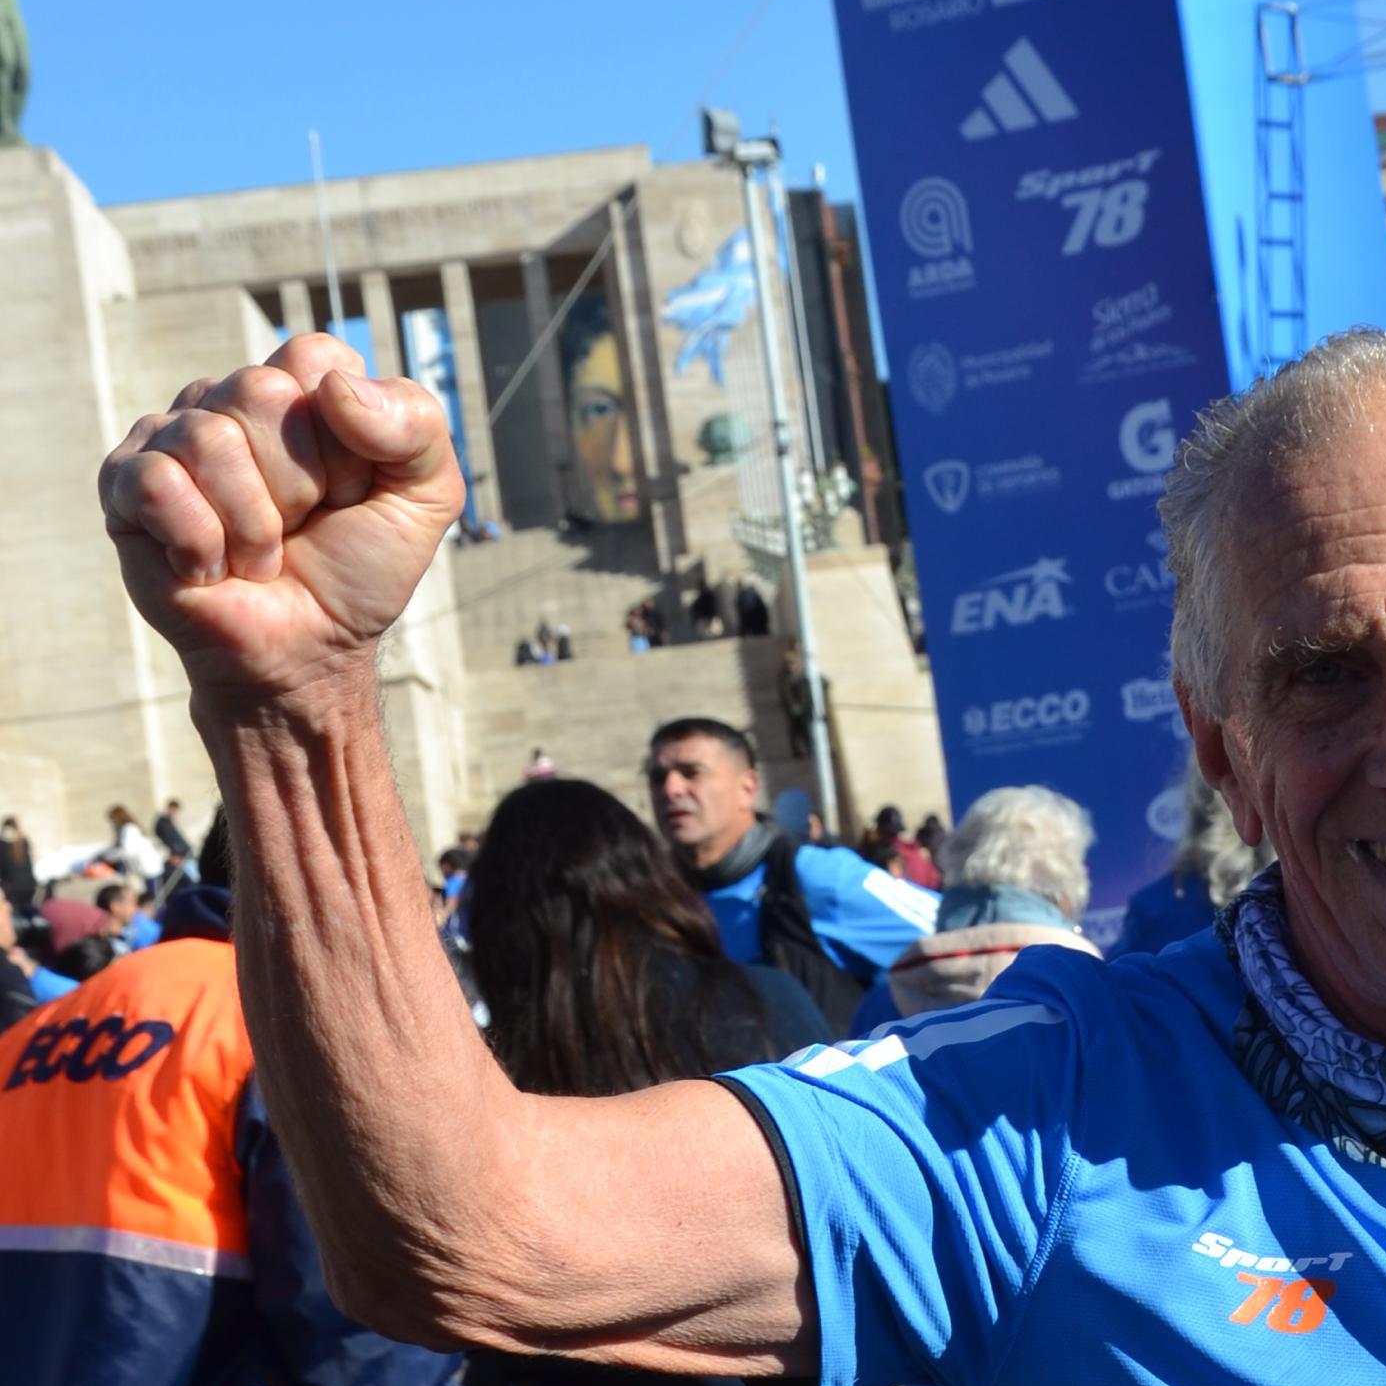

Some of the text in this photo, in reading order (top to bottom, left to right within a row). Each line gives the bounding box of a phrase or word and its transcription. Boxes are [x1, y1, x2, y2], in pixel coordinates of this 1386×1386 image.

[1061, 179, 1148, 256] 78
[951, 580, 1065, 635] ENA
[990, 689, 1090, 733] ECCO
[2, 1015, 175, 1092] ECCO
[1229, 1271, 1337, 1333] 78
